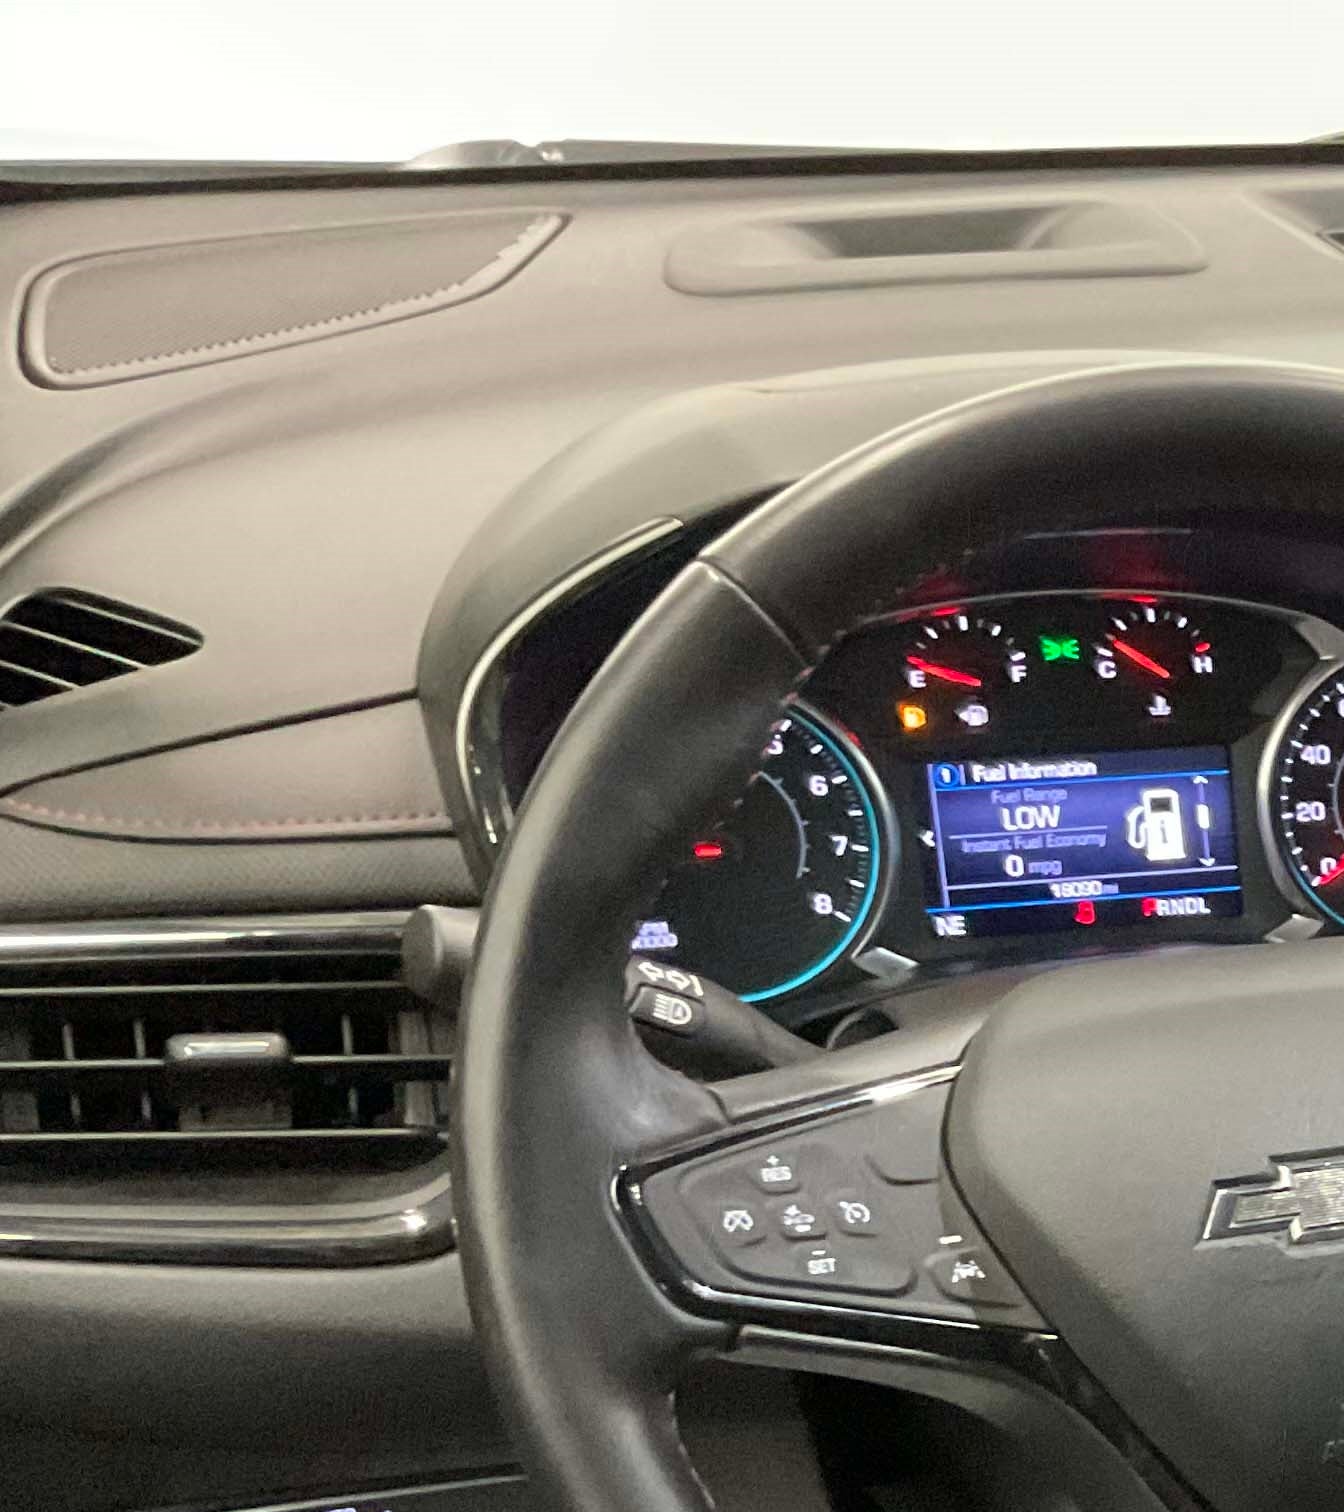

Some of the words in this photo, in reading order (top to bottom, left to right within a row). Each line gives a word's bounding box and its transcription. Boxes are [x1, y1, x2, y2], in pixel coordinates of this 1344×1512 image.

[1010, 665, 1027, 683] F
[1098, 661, 1117, 679] C
[1193, 655, 1213, 673] H
[908, 670, 926, 688] E
[1300, 744, 1331, 765] 40
[972, 763, 1006, 783] Fuel
[1007, 760, 1098, 780] Information
[809, 775, 829, 797] 6
[991, 789, 1021, 804] Fuel
[1023, 787, 1068, 804] Range
[1001, 804, 1061, 831] LOW
[1295, 801, 1326, 822] 20
[831, 835, 848, 857] 7
[1014, 834, 1043, 849] Fuel
[1004, 854, 1025, 877] 0
[1028, 860, 1063, 876] mpg
[1319, 857, 1337, 875] 0
[813, 892, 833, 915] 8
[932, 914, 967, 936] NE
